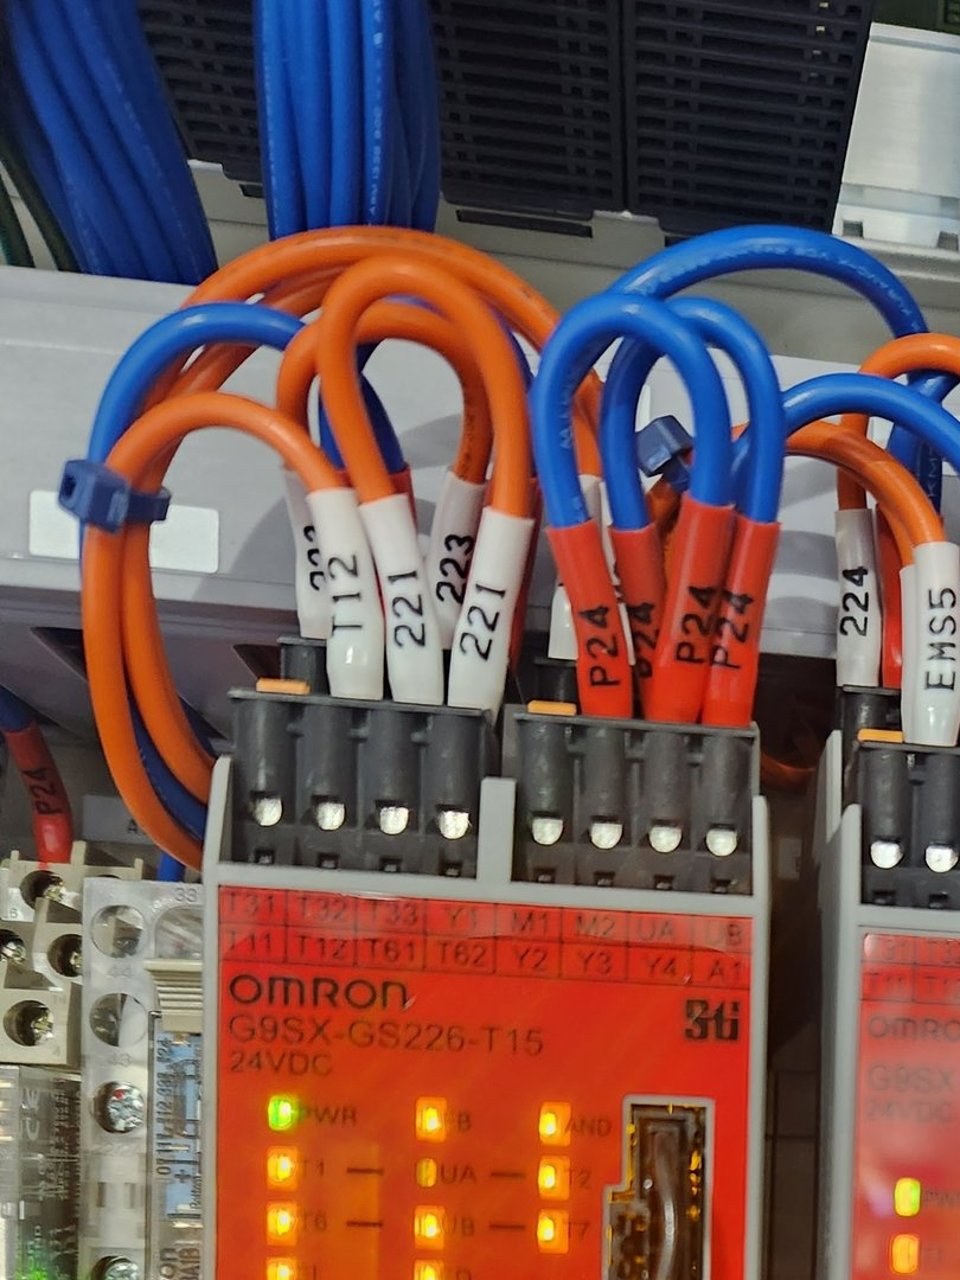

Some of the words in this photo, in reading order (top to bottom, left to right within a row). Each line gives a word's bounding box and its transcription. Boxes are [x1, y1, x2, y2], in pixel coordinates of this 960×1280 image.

[329, 553, 363, 637] T12
[437, 533, 476, 605] 223
[840, 565, 871, 637] 224
[387, 569, 428, 650] 221
[459, 583, 507, 662] 221
[674, 584, 719, 665] P24
[709, 588, 755, 671] P24
[924, 586, 958, 692] EMS5
[584, 605, 621, 689] P24
[24, 766, 64, 817] P24
[298, 932, 346, 958] T12
[367, 937, 417, 964] T61
[438, 940, 487, 968] T62
[513, 944, 549, 971] Y2
[577, 949, 613, 974] Y3
[645, 954, 679, 978] Y4
[708, 957, 744, 981] A1
[369, 900, 419, 928] T33
[511, 911, 550, 935] M1
[576, 914, 616, 938] M2
[635, 918, 675, 942] UA
[227, 1013, 545, 1058] G9SX-GS226-T15
[228, 1050, 333, 1078] 24VDC
[439, 1166, 477, 1186] UA
